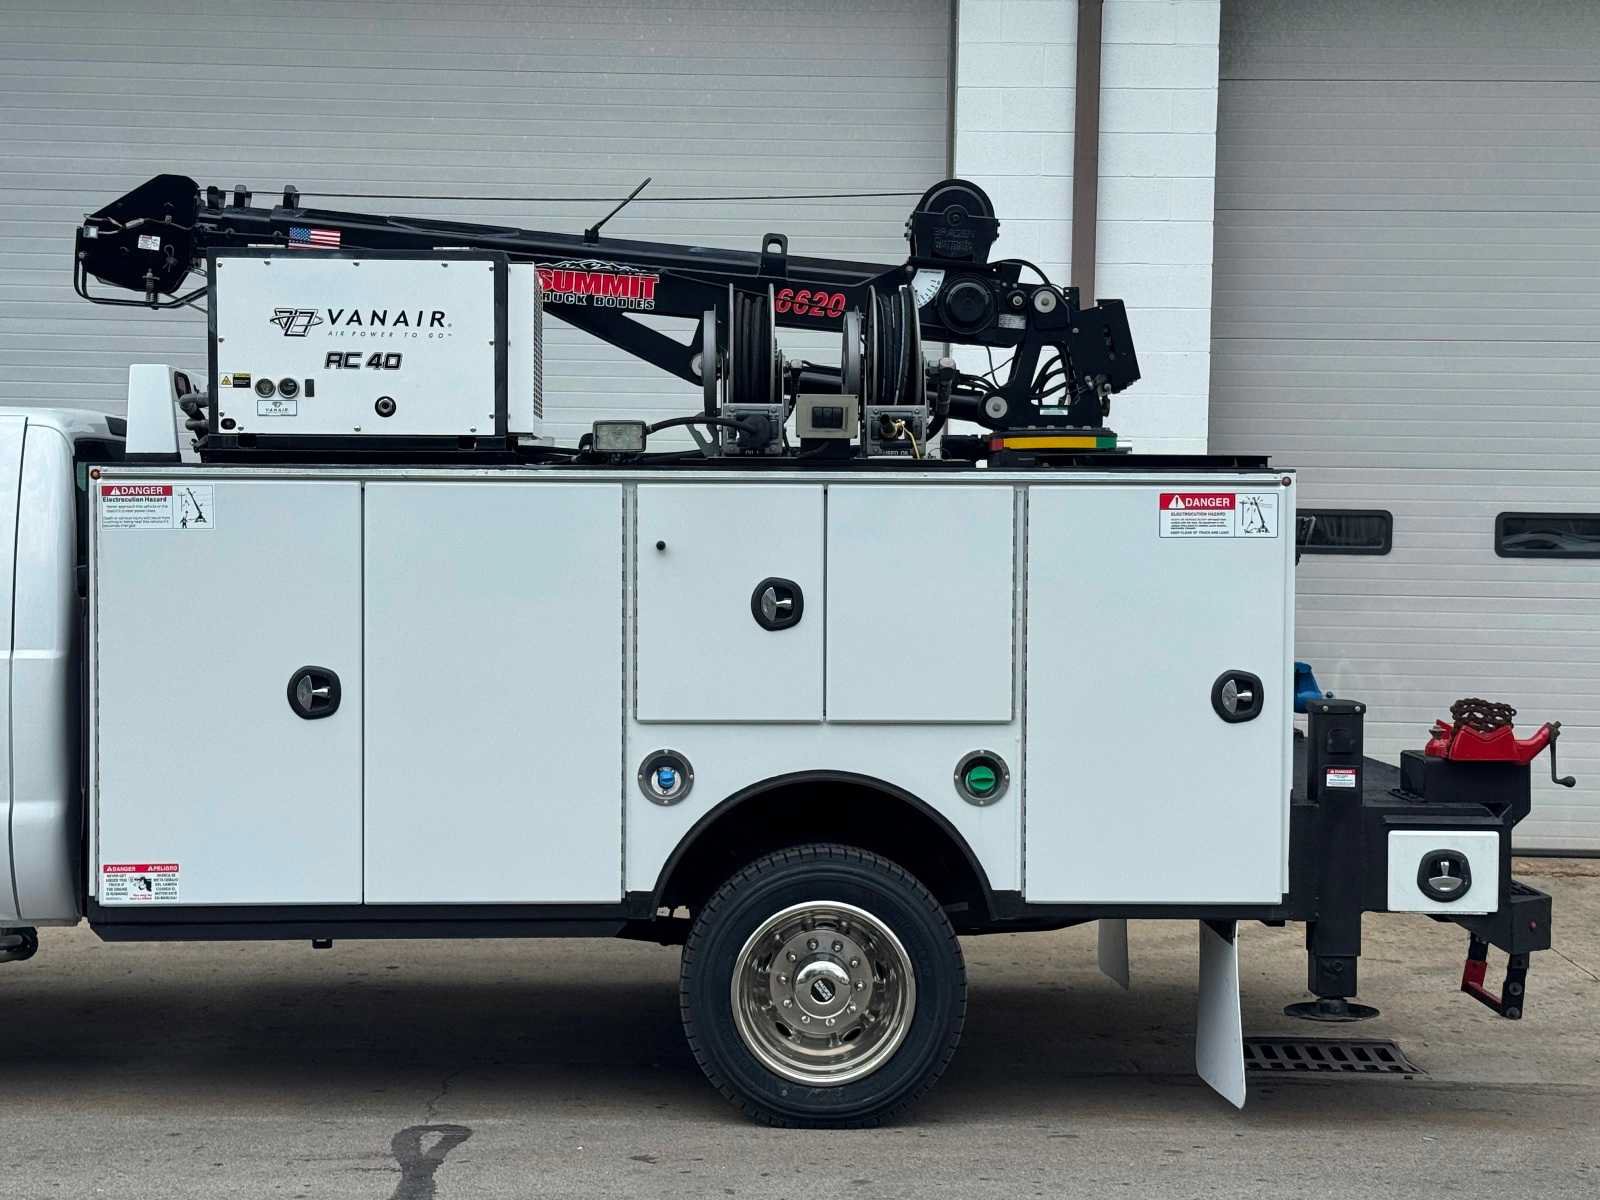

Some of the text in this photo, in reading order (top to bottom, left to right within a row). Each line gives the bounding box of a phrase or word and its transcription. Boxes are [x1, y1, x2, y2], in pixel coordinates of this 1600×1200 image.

[535, 267, 660, 299] SUMMIT
[542, 291, 655, 310] RUCK BODIES
[775, 288, 846, 318] 6620
[327, 308, 446, 328] VANAIR
[404, 331, 418, 339] TO
[323, 351, 403, 370] RC 40
[121, 486, 163, 495] DANGER
[1185, 497, 1230, 507] DANGER
